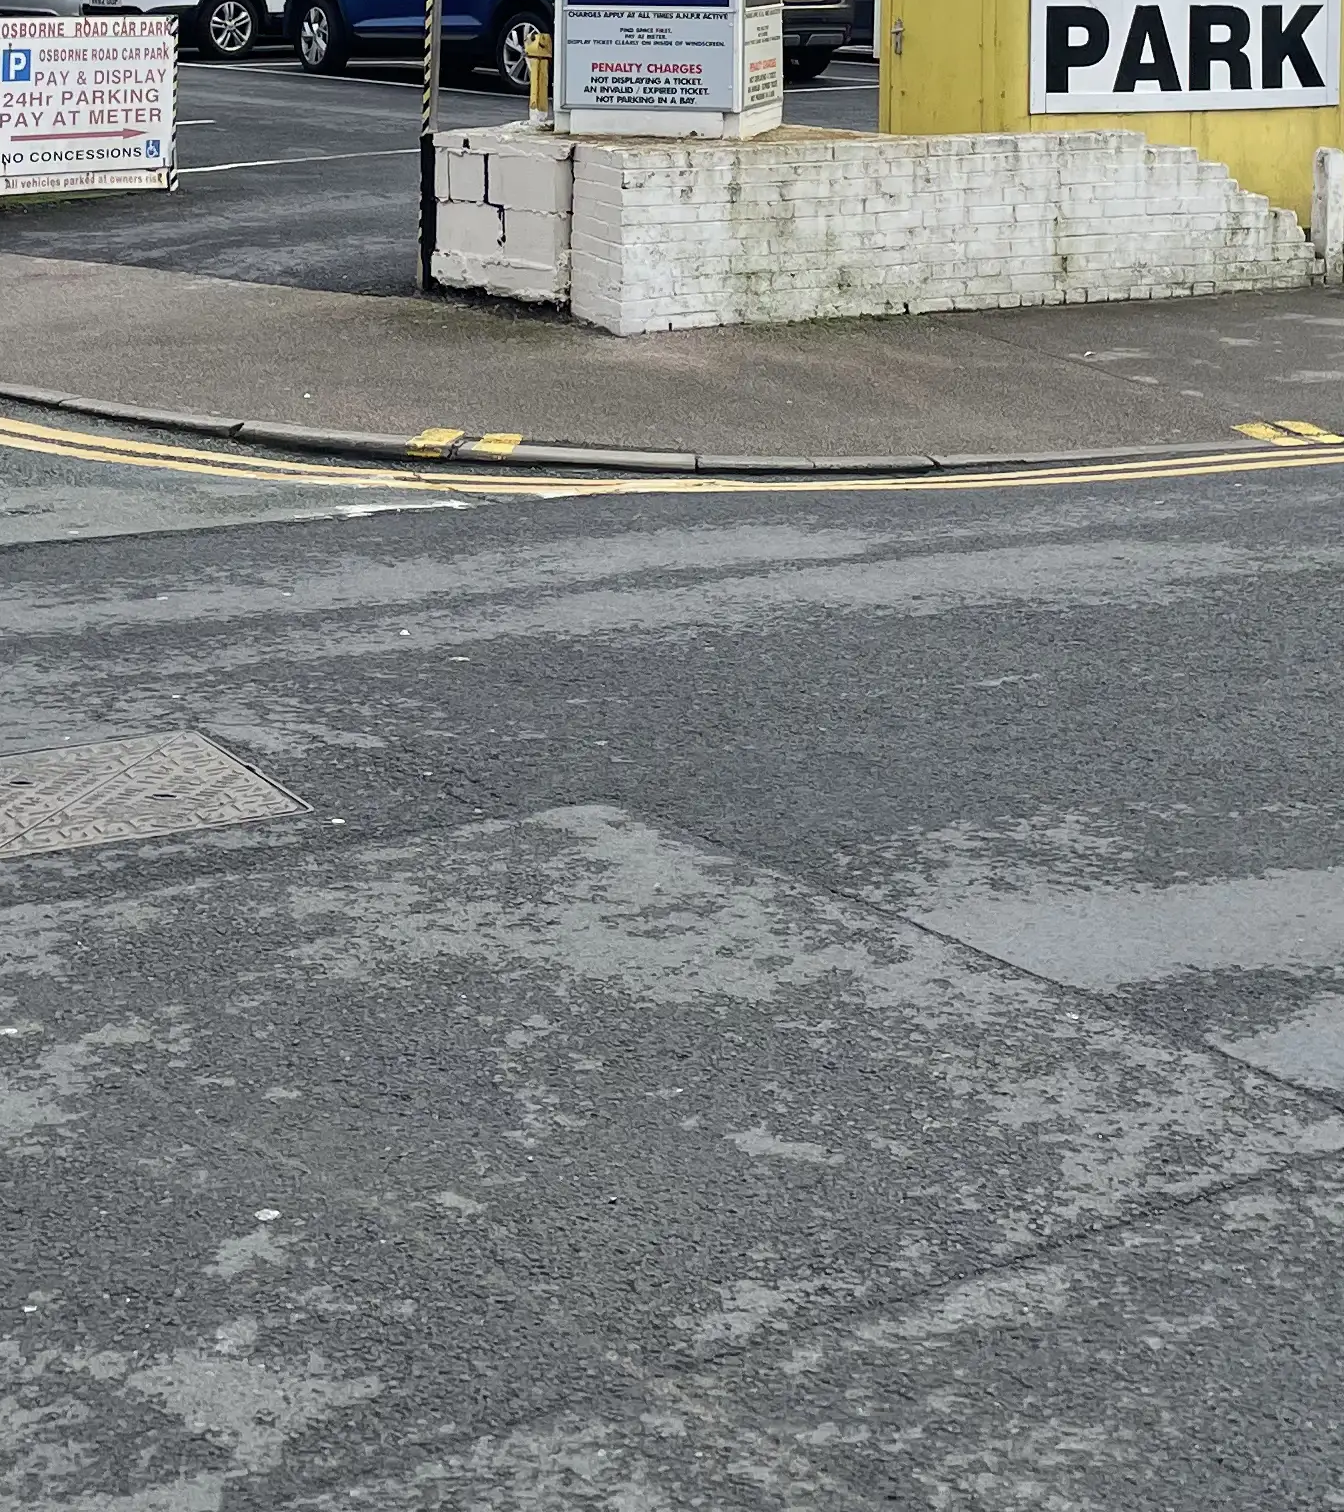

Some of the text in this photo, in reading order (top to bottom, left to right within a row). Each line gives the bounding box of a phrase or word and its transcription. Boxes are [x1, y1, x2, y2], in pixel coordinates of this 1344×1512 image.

[1, 21, 172, 39] OSBORNE ROAD CAR PARK
[39, 46, 169, 62] OSBORNE ROAD CAR PARK
[1046, 4, 1325, 93] PARK
[591, 63, 702, 75] PENALTY CHARGES
[35, 69, 167, 86] PAY & DISPLAY
[612, 77, 661, 85] DISPLAYING
[3, 88, 159, 108] 24Hr PARKING
[643, 87, 677, 95] EXPIRED
[617, 96, 654, 104] PARKING
[0, 108, 162, 128] PAY AT METER
[1, 147, 142, 164] NO CONCESSIONS
[5, 173, 163, 189] All vehicles parked at owners risk
